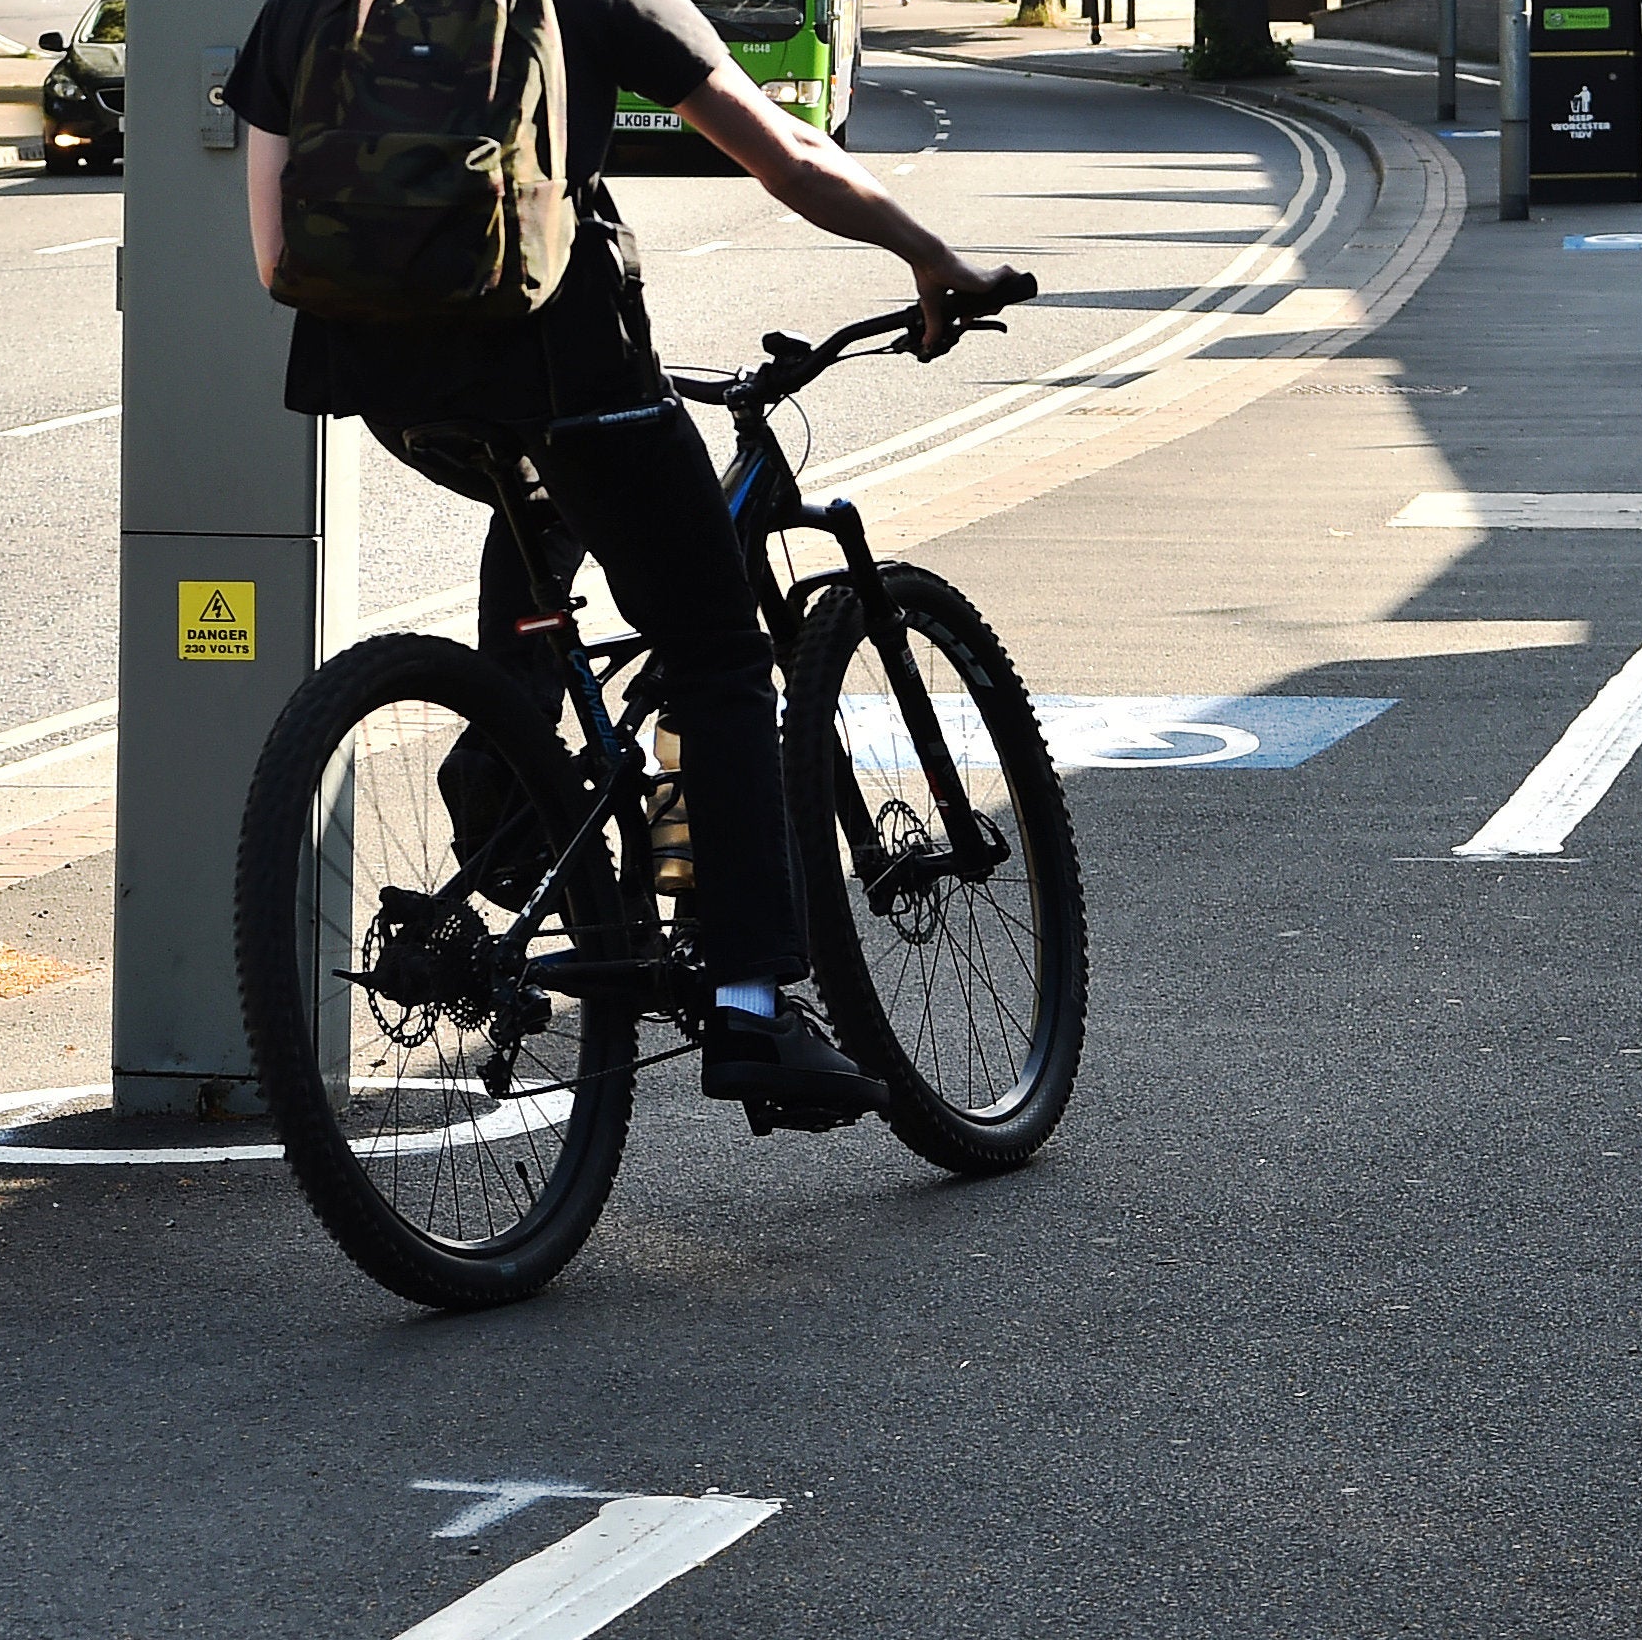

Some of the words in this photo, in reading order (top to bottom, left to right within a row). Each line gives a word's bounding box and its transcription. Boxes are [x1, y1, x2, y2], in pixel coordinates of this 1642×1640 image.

[615, 113, 651, 128] LK08
[654, 114, 680, 128] FMJ
[1568, 114, 1593, 122] KEEP
[1550, 122, 1611, 131] WORCESTER
[1570, 130, 1592, 139] TIDY
[187, 629, 248, 641] DANGER
[184, 644, 206, 654] 230
[209, 644, 250, 654] VOLTS
